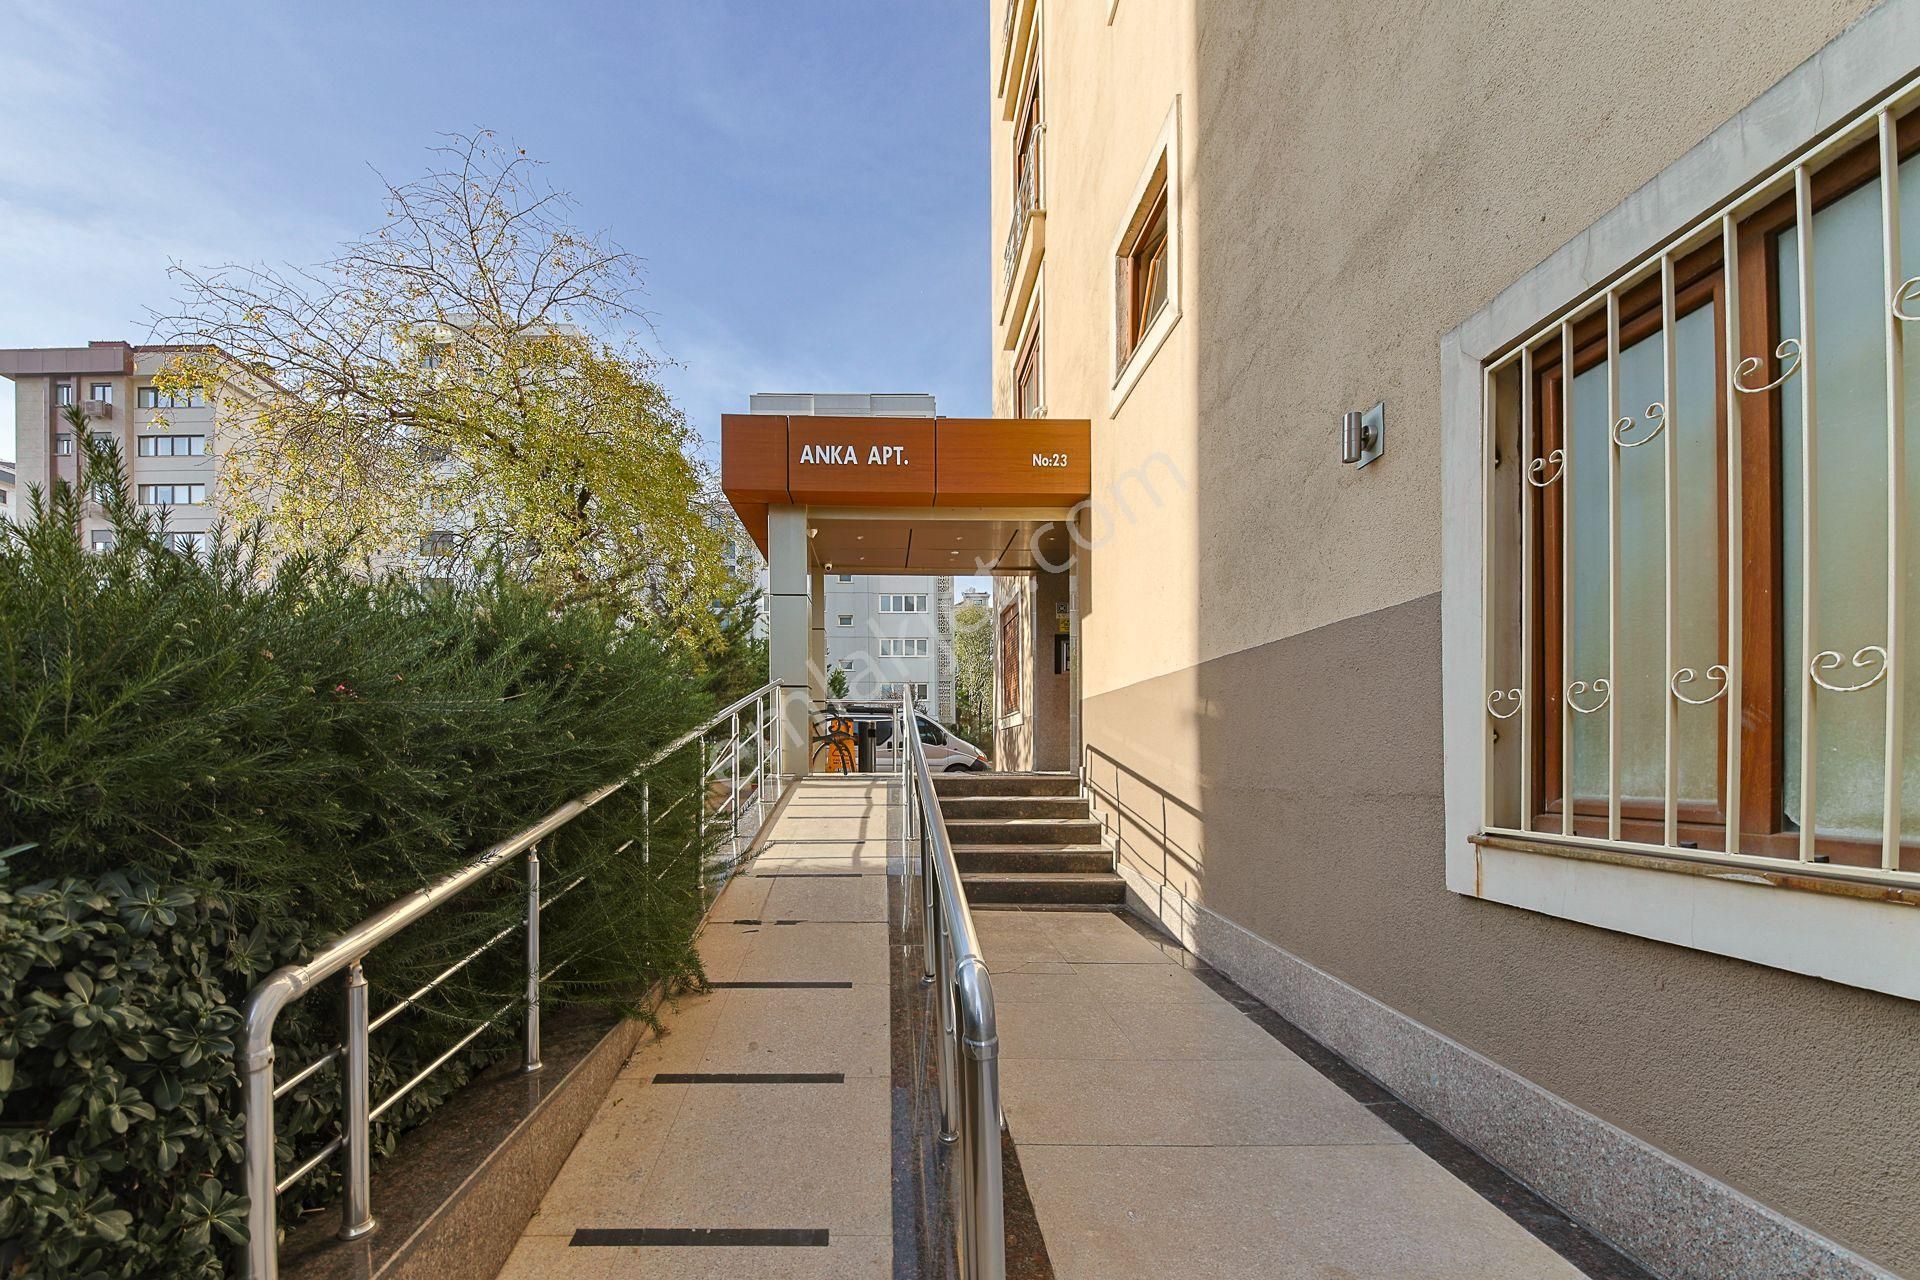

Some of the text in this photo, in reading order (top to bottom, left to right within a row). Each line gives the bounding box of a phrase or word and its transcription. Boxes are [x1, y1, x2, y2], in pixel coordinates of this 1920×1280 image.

[799, 444, 909, 466] ANKA APT.
[1032, 453, 1068, 468] No:23
